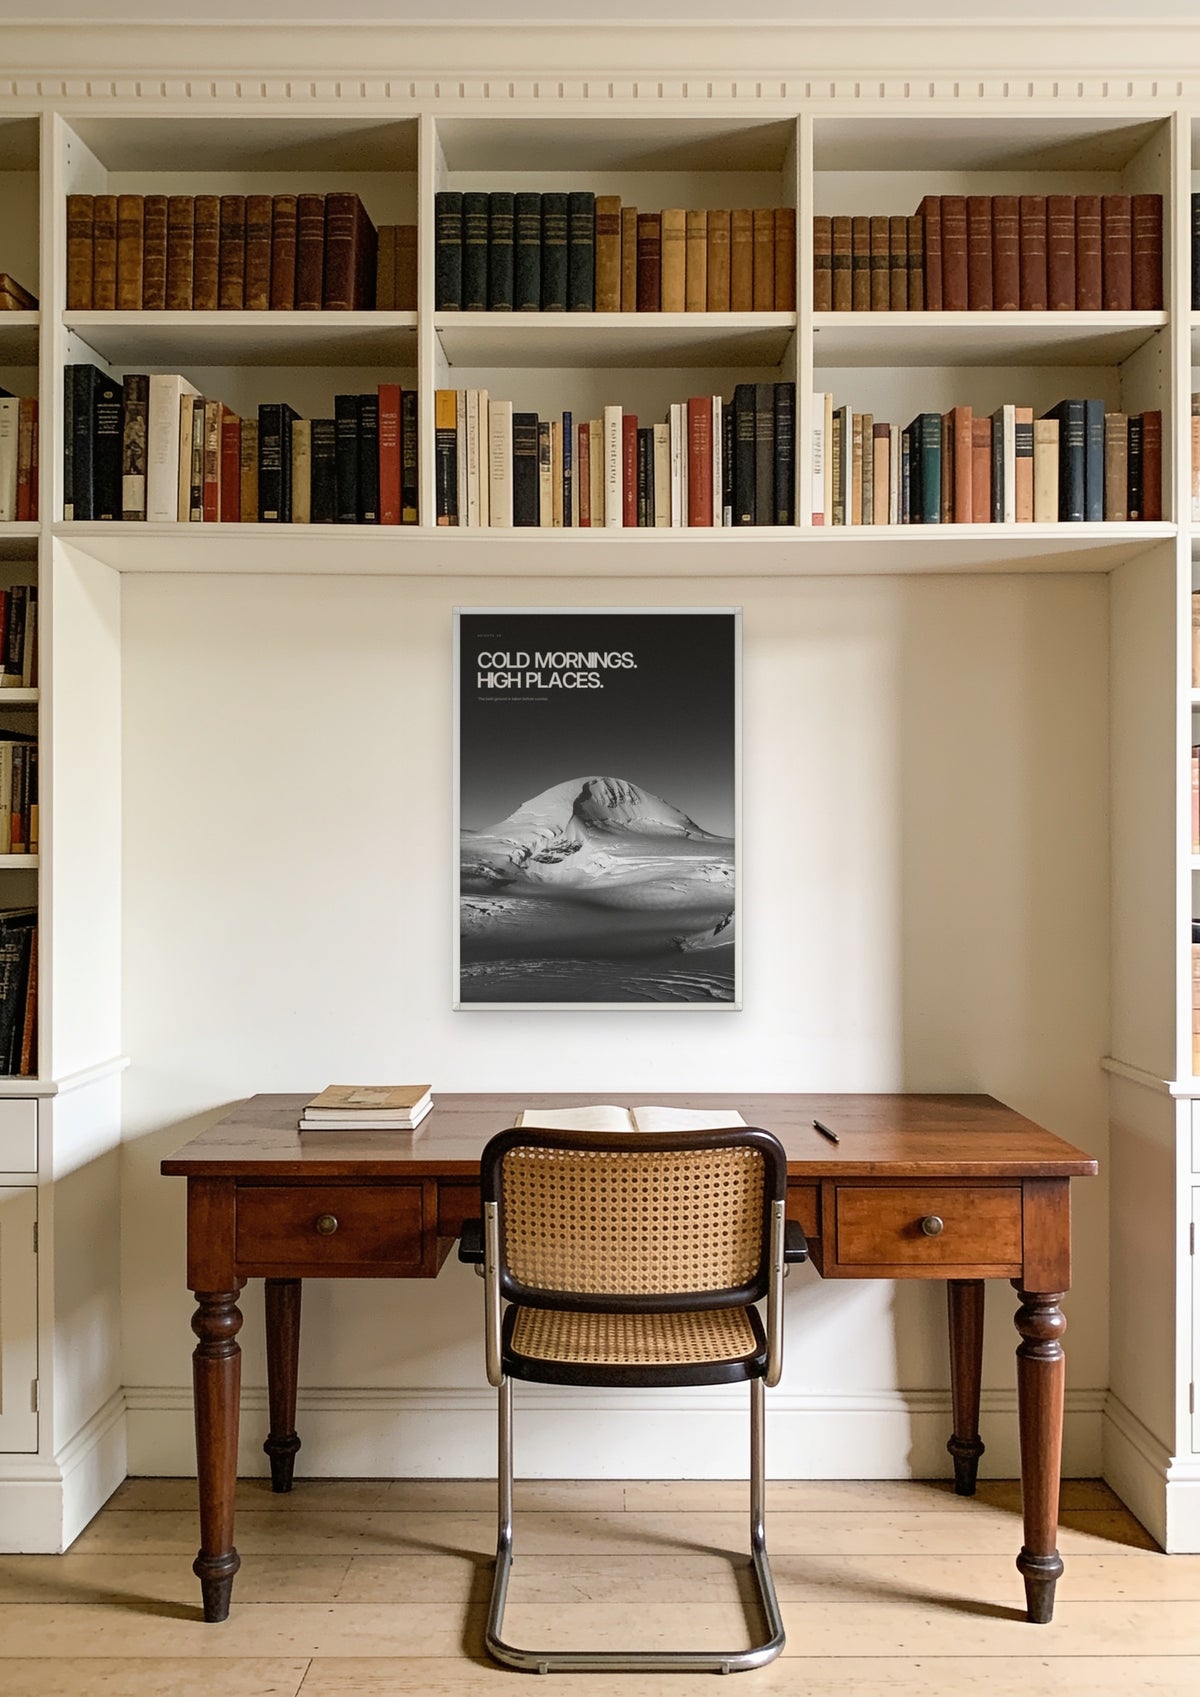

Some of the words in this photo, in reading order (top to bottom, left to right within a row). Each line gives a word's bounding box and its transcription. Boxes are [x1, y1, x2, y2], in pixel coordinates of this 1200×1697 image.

[478, 651, 530, 668] COLD
[535, 651, 637, 668] MORNINGS.
[478, 671, 521, 688] HIGH
[526, 671, 605, 688] PLACES.
